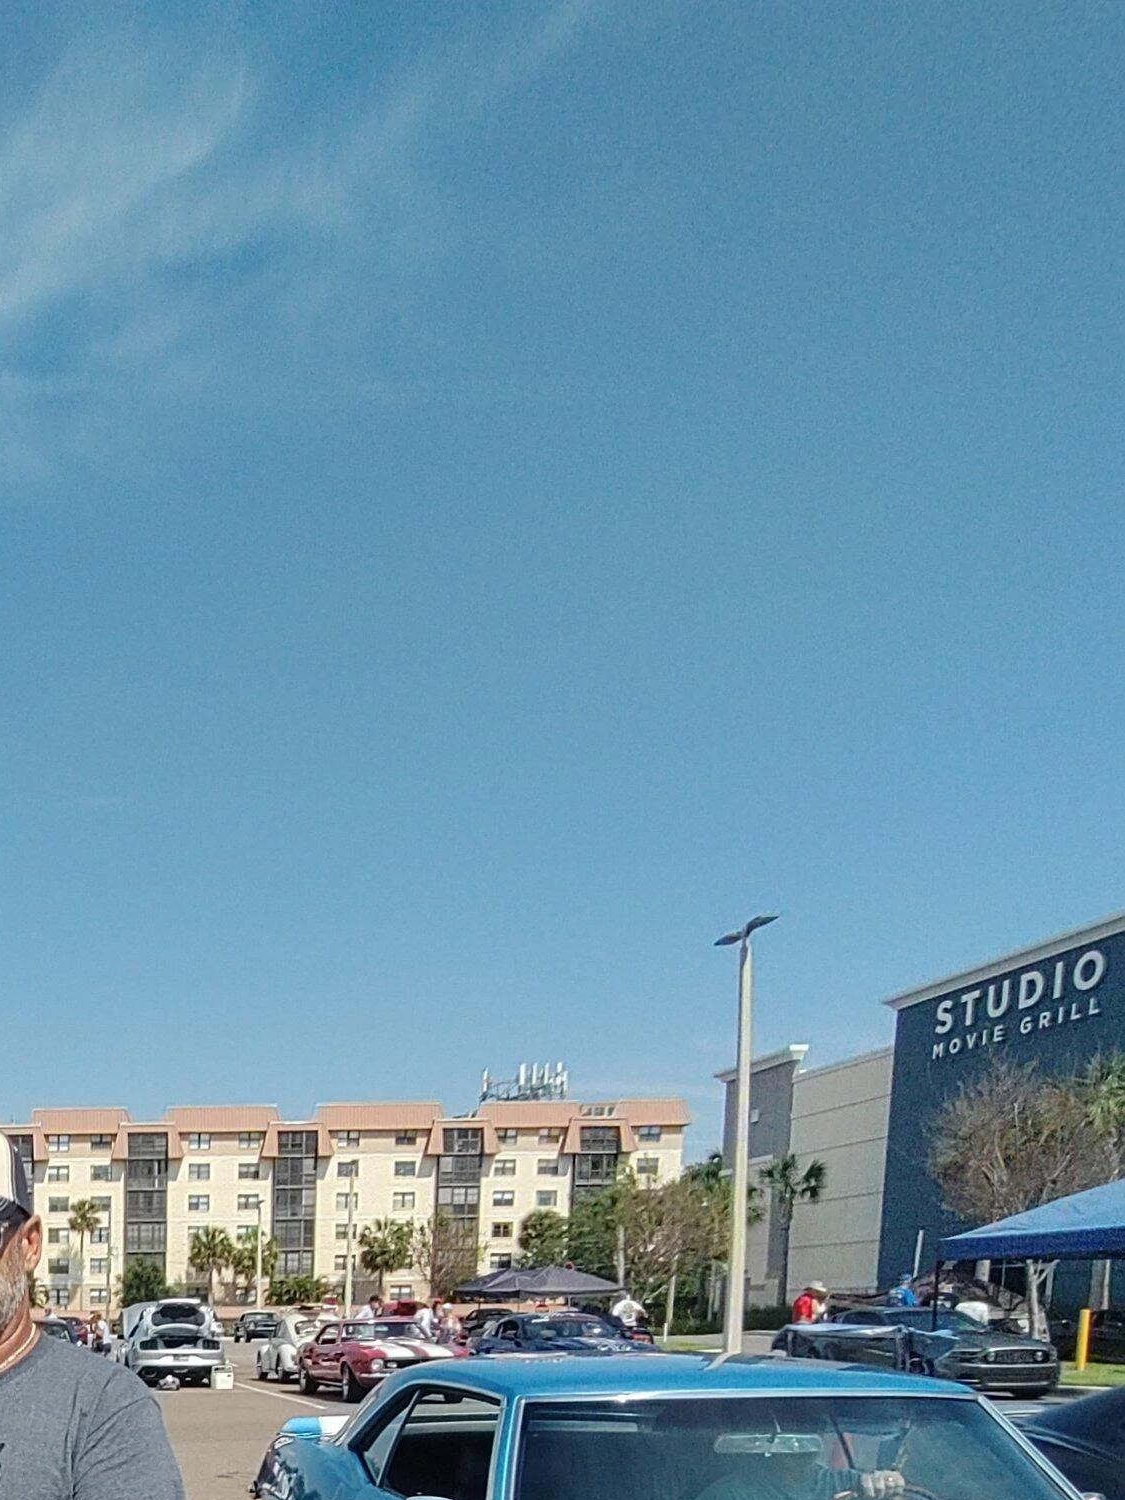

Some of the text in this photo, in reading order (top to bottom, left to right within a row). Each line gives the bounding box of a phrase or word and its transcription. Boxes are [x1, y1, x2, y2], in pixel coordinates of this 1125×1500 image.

[932, 997, 1101, 1059] MOVIE GRILL
[935, 950, 1105, 1035] STUDIO
